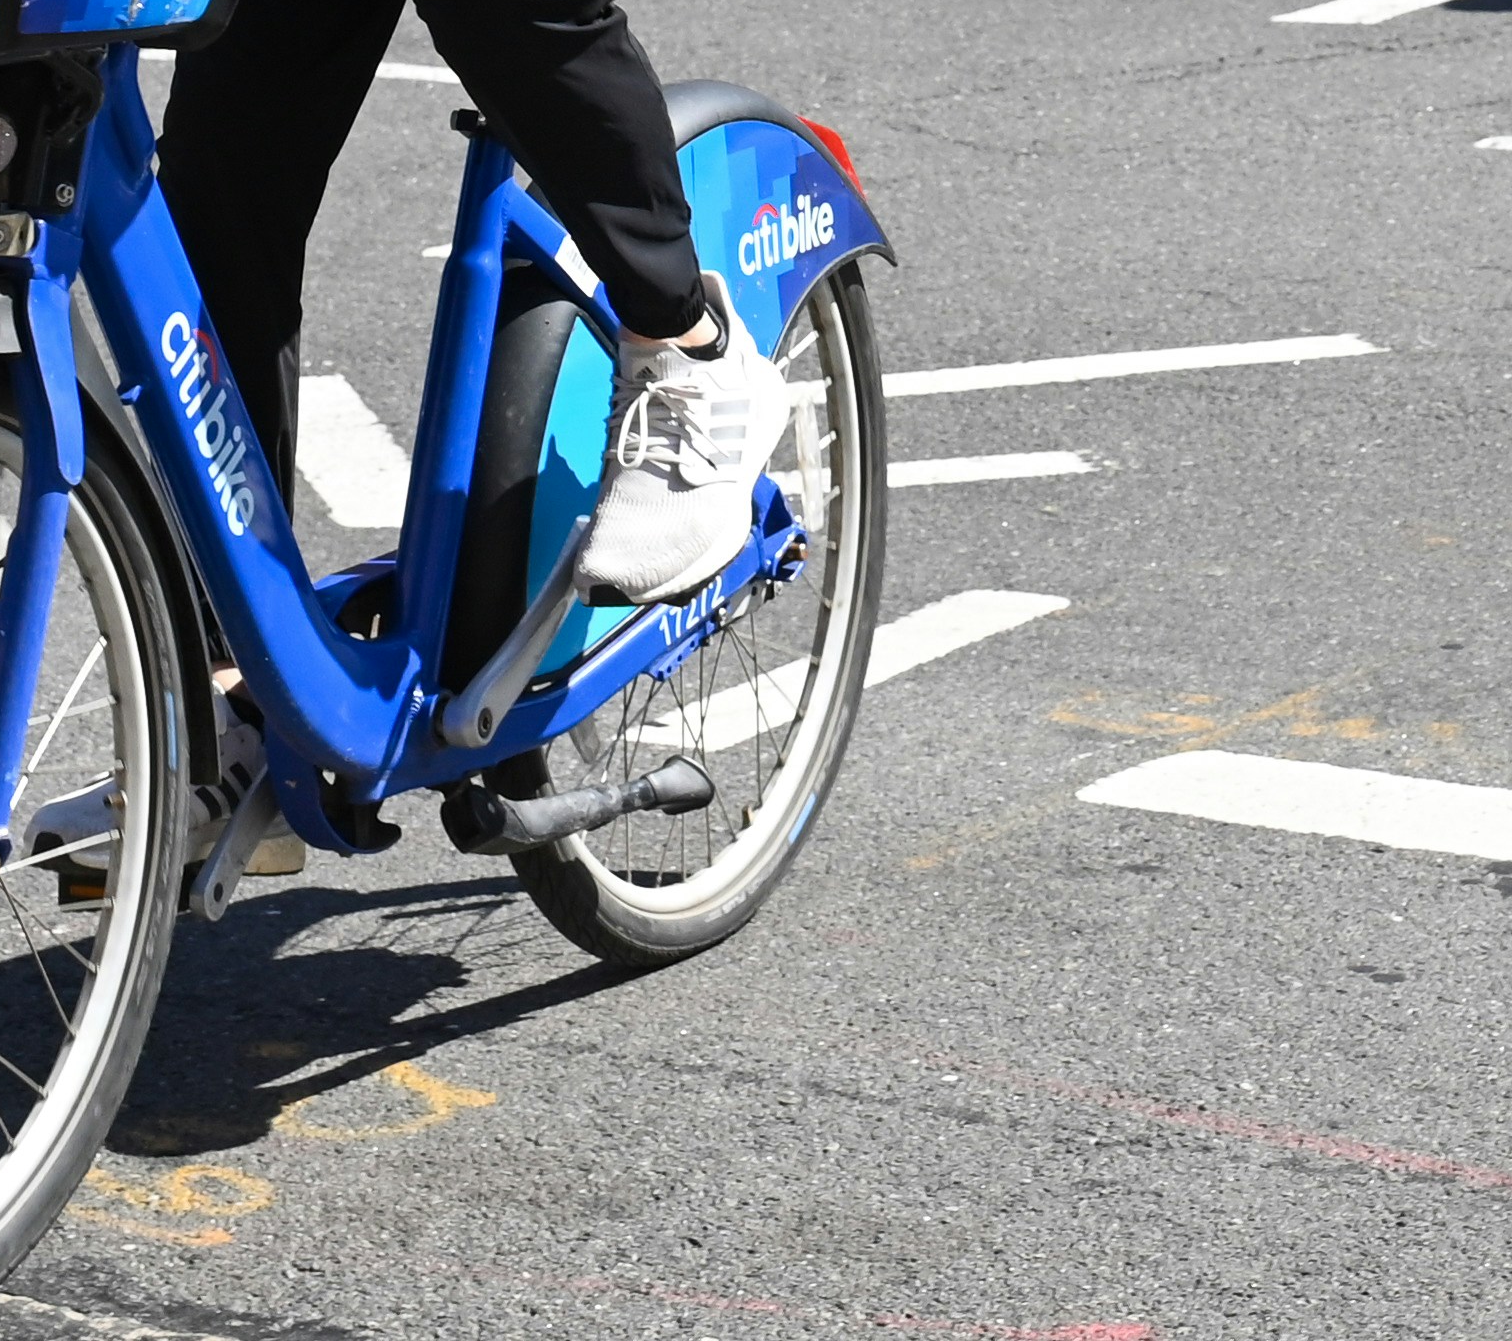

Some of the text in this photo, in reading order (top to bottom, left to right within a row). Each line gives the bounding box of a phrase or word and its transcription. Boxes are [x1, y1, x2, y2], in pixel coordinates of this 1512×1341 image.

[738, 194, 834, 276] citi bike
[161, 311, 255, 537] citi bike
